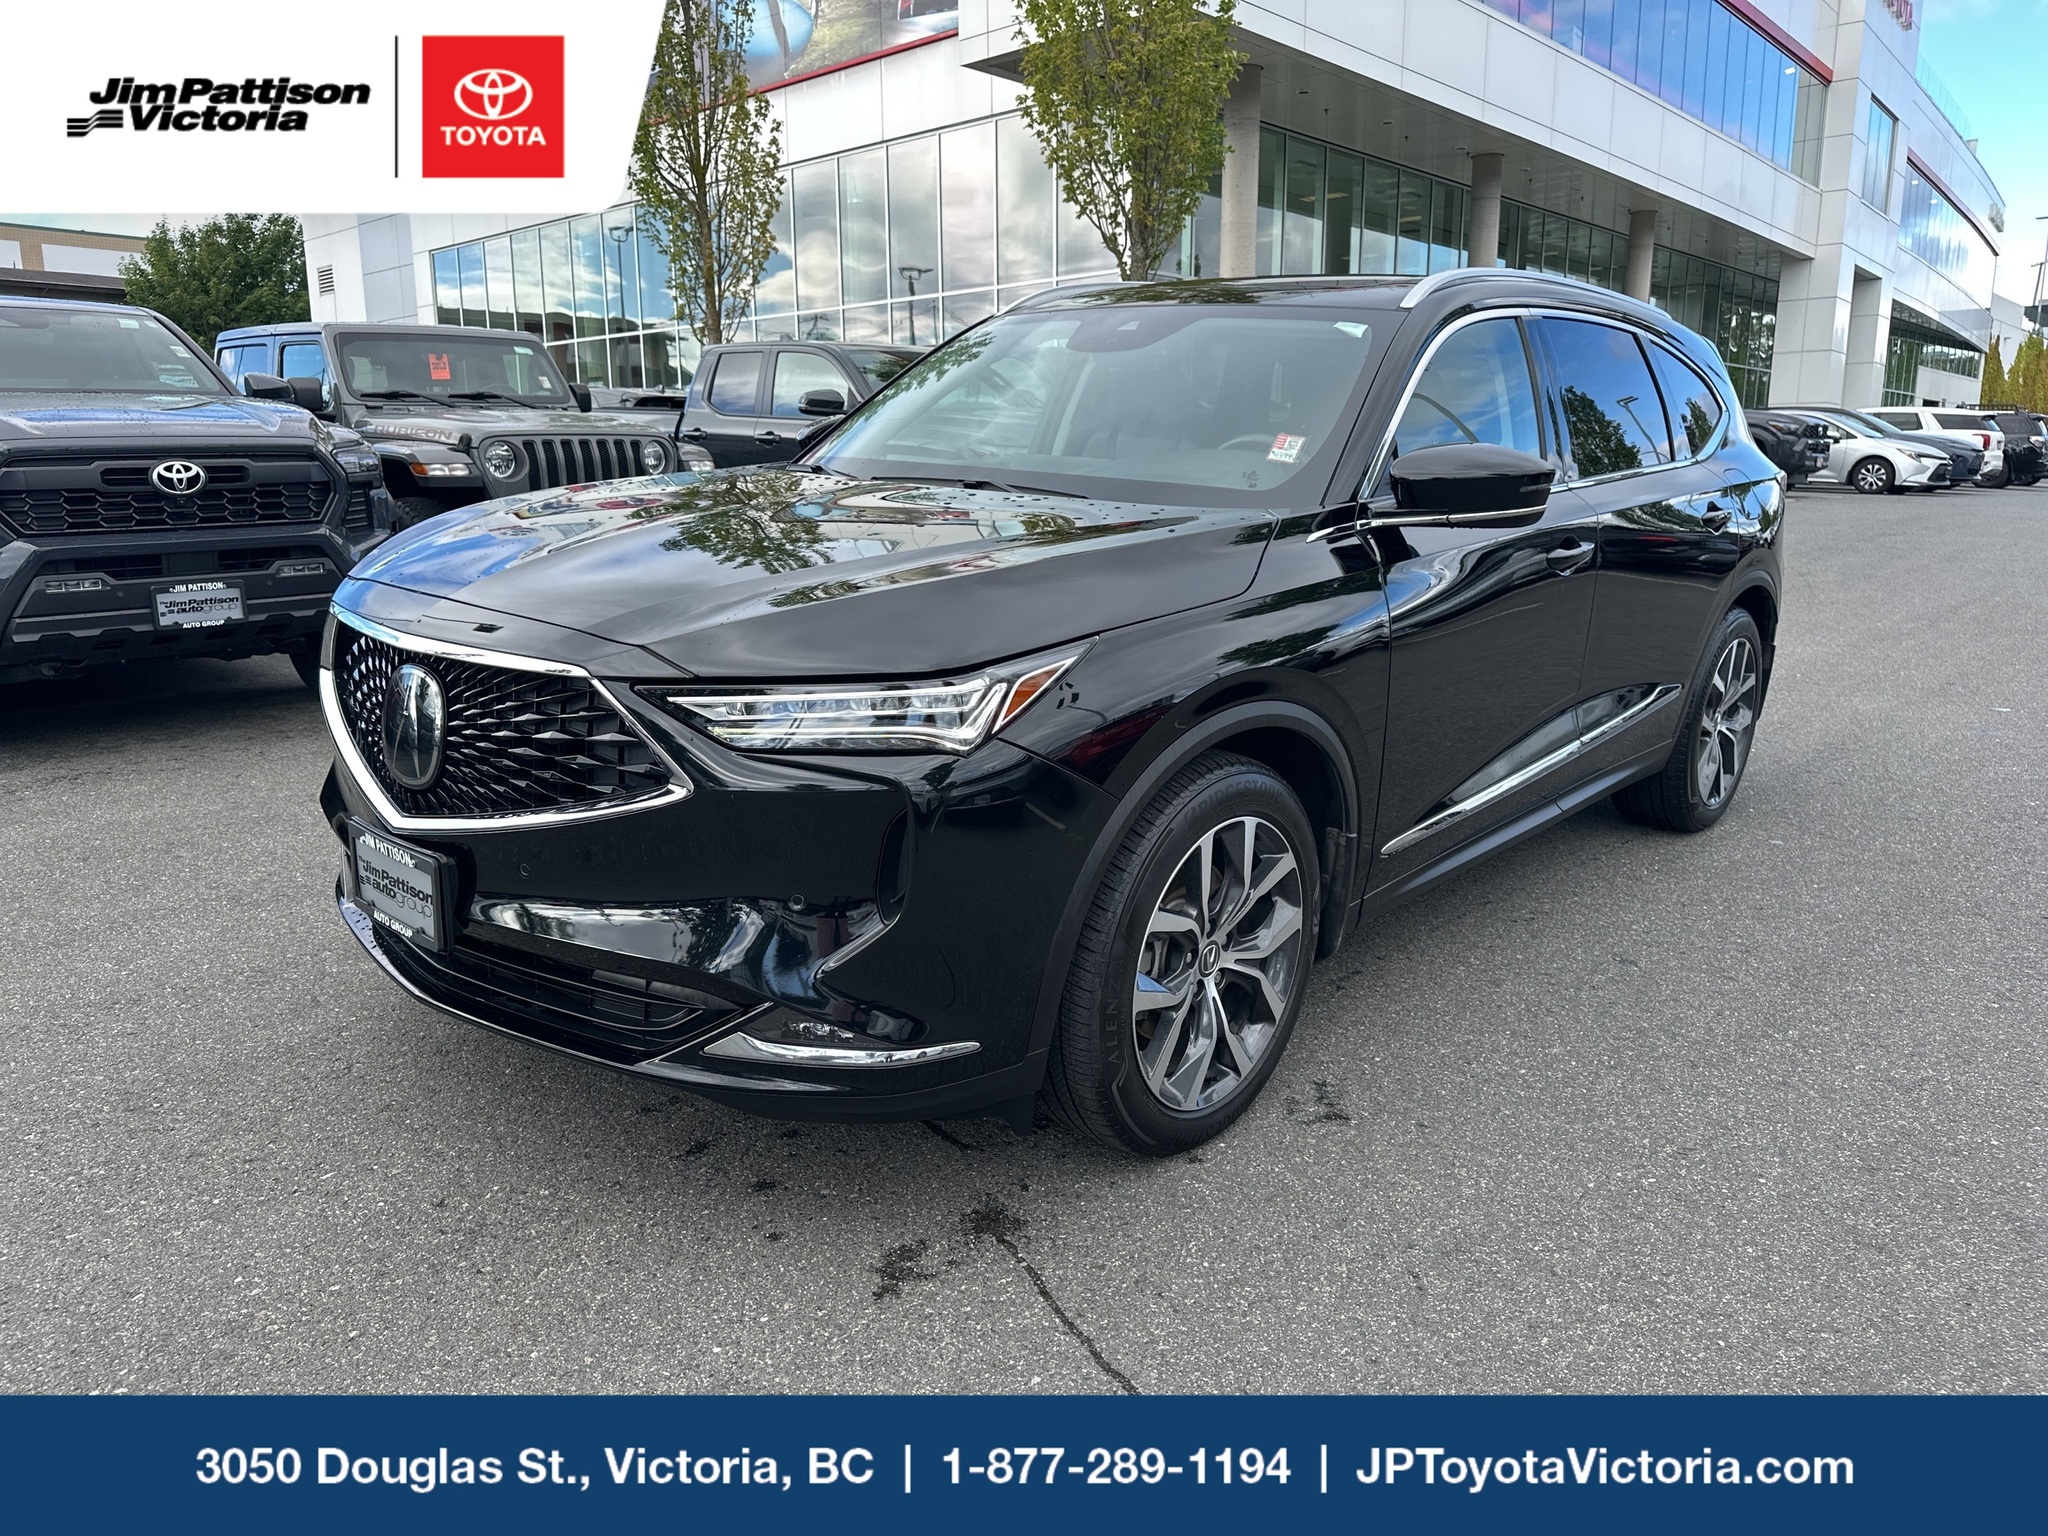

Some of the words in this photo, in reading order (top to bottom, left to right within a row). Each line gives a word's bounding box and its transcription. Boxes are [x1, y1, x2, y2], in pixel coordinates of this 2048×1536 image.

[374, 424, 453, 440] RUBICON
[173, 584, 187, 593] JIM
[188, 582, 223, 592] PATTISON
[182, 621, 201, 629] AUTO
[202, 619, 225, 628] GROUP
[375, 840, 411, 868] PATTISON
[373, 909, 390, 926] AUTO
[391, 919, 413, 939] GROUP
[1106, 957, 1125, 1064] ALENZA
